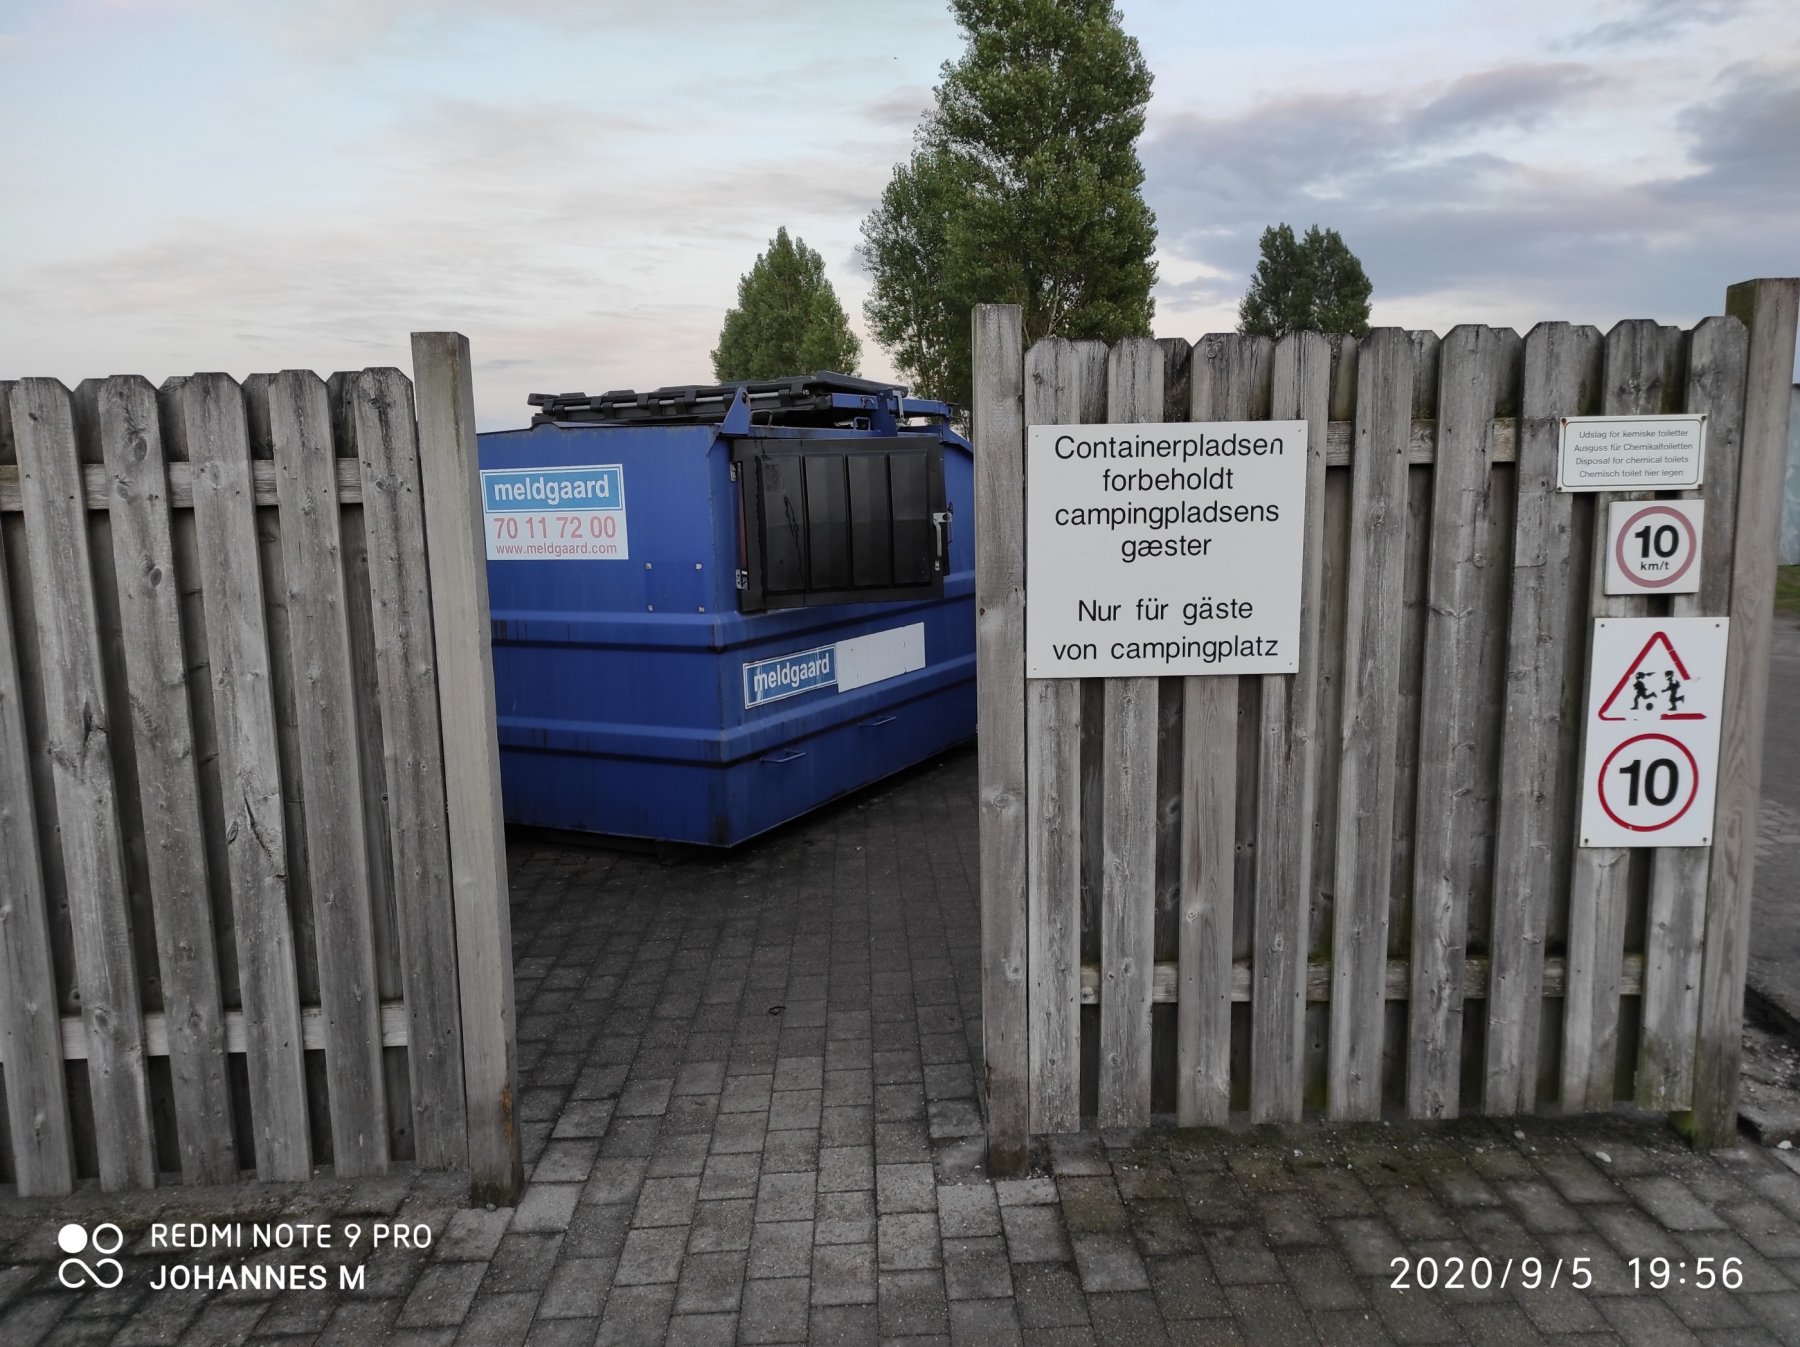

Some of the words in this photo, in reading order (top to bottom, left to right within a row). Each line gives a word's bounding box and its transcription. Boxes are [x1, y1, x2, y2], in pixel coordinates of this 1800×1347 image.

[1055, 433, 1283, 462] Containerpladsen
[1574, 444, 1608, 453] Ausguss
[1610, 443, 1621, 451] für
[1579, 431, 1607, 439] Udslag
[1622, 430, 1656, 438] kemiske
[1658, 429, 1688, 437] toiletter
[1576, 457, 1610, 466] Disposal
[1626, 456, 1662, 464] chemical
[1664, 455, 1689, 463] toilets
[1579, 470, 1620, 478] Chemisch
[1622, 469, 1642, 477] toilet
[1644, 469, 1659, 477] hier
[494, 474, 610, 505] meldgaard
[1103, 467, 1233, 491] forbeholdt
[494, 517, 518, 539] 70
[525, 516, 547, 539] 11
[556, 516, 583, 539] 72
[590, 515, 616, 539] 00
[1055, 500, 1280, 530] campingpladsens
[496, 542, 617, 557] www.meldgaard.com
[1121, 535, 1212, 563] gæster
[1635, 525, 1679, 558] 10
[1640, 561, 1669, 571] km/t
[1078, 599, 1121, 622] Nur
[1136, 597, 1169, 621] für
[1182, 596, 1254, 626] gäste
[1052, 642, 1097, 660] von
[1110, 635, 1279, 664] campingplatz
[754, 653, 829, 691] meldgaard
[1619, 758, 1679, 806] 10
